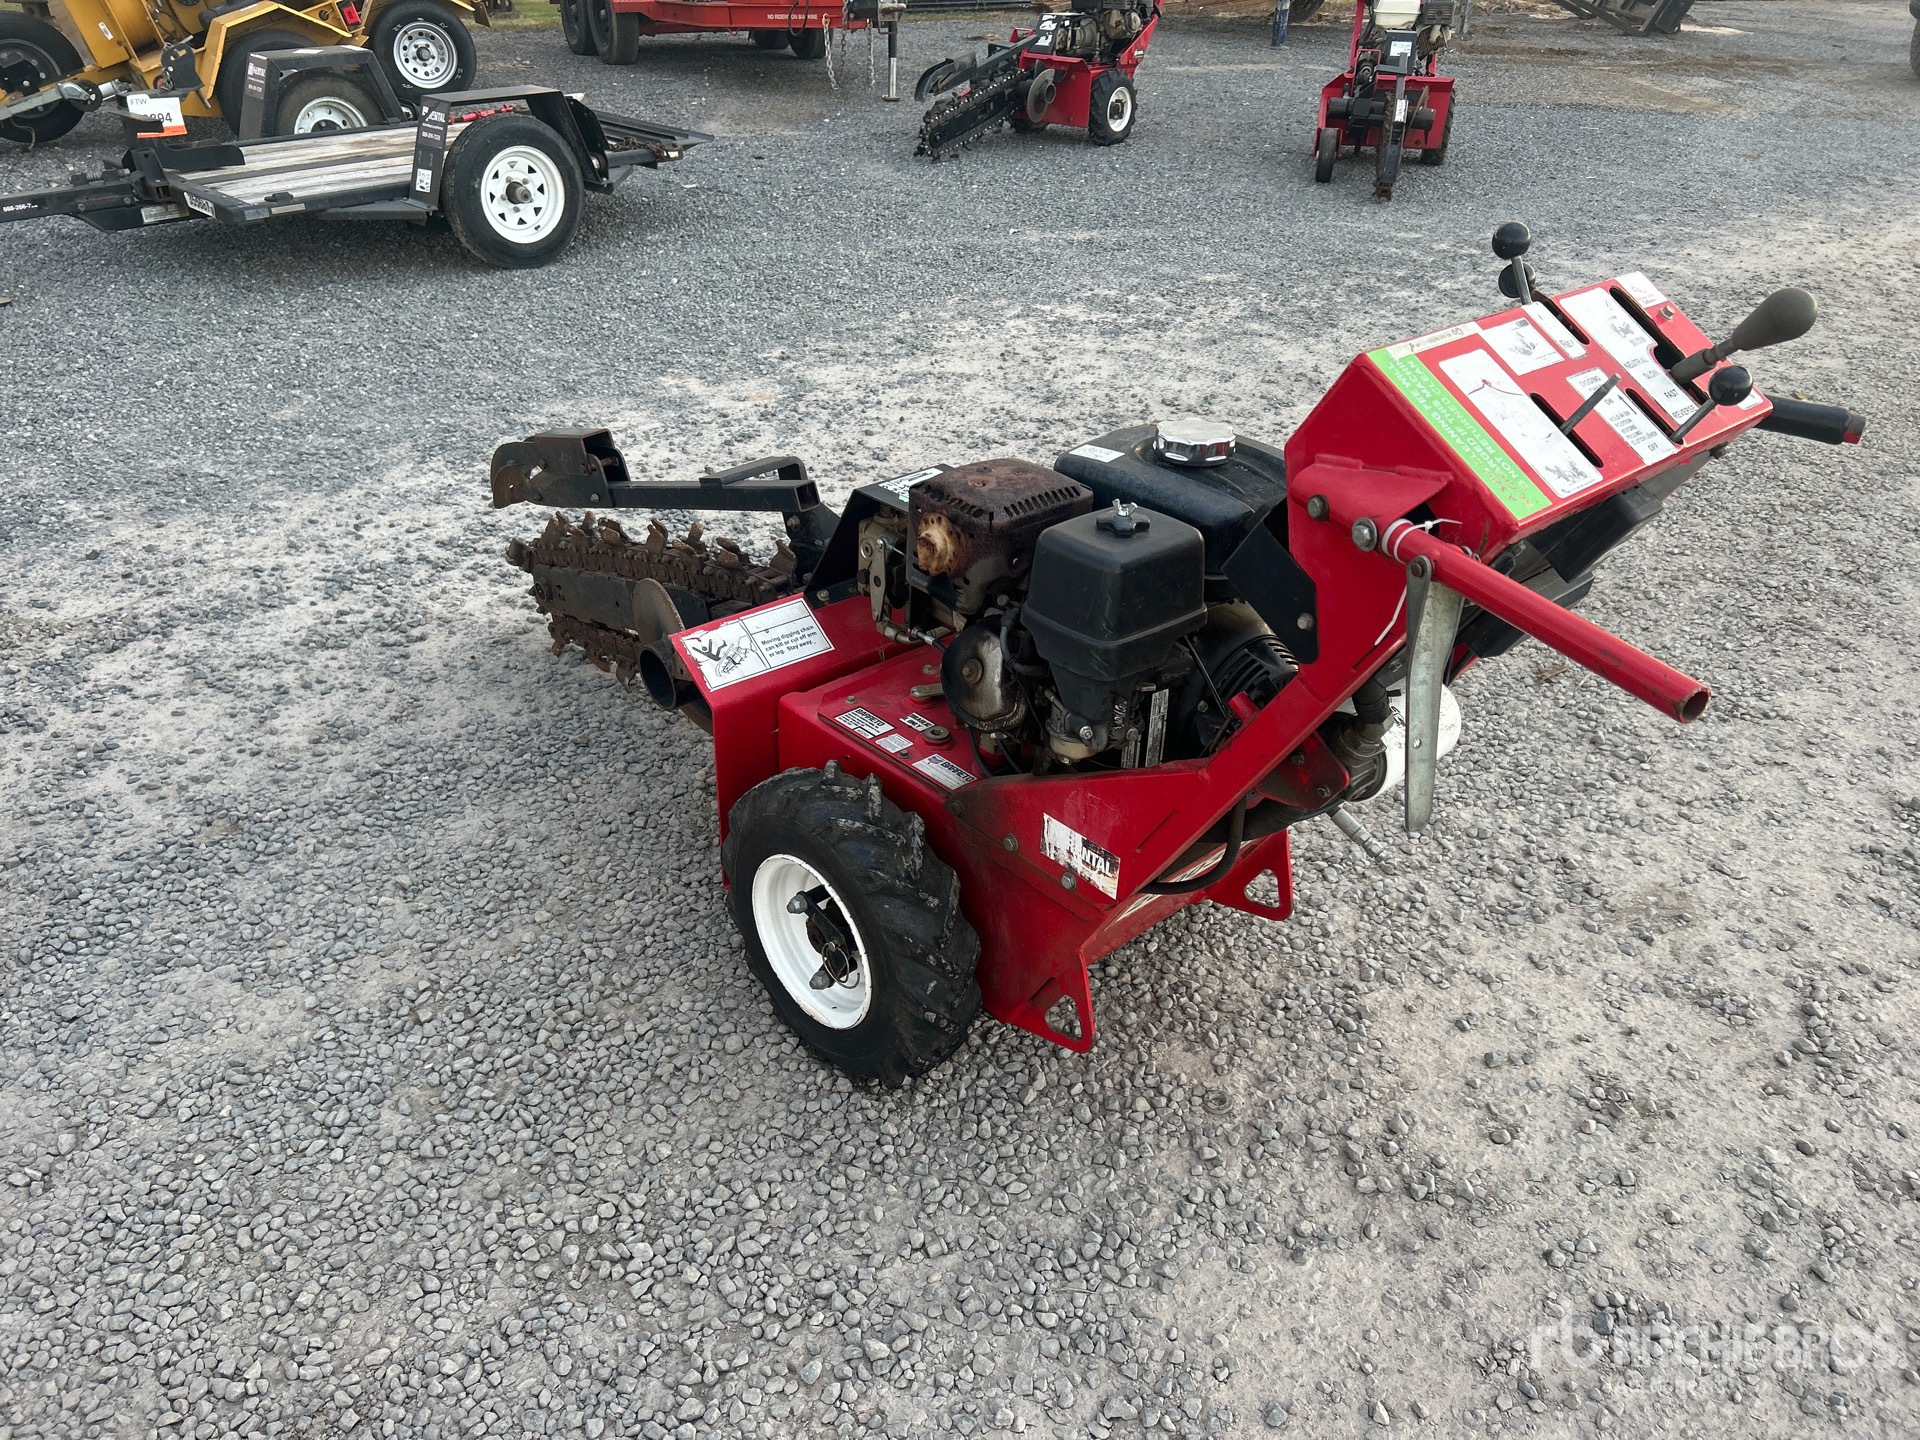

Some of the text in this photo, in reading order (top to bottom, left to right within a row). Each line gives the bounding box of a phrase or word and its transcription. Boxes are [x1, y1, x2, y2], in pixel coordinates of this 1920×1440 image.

[143, 112, 173, 123] 94
[1622, 355, 1650, 370] NEUTRAL
[1383, 360, 1413, 388] WILL
[1389, 354, 1433, 398] MACHIN
[1406, 358, 1442, 395] CLEAN
[1577, 375, 1603, 387] DIGGING
[1641, 368, 1661, 380] SLOW
[1408, 388, 1433, 411] FEE
[1603, 397, 1615, 405] ON
[1662, 388, 1680, 399] FAST
[1430, 398, 1457, 424] THIS
[1671, 404, 1699, 420] REVERSE
[1440, 394, 1496, 454] RETURNED
[1453, 424, 1468, 436] IF
[1619, 423, 1638, 434] BEFORE
[1429, 410, 1484, 467] CLEANING
[1625, 429, 1643, 440] PULLING
[1646, 441, 1660, 452] OFF
[1464, 435, 1518, 491] CHARGED
[1492, 453, 1519, 479] NOT
[761, 637, 781, 645] Moving
[781, 630, 800, 640] digging
[786, 643, 799, 651] Stay
[854, 708, 886, 726] BARRETO
[940, 760, 974, 782] BARRETO
